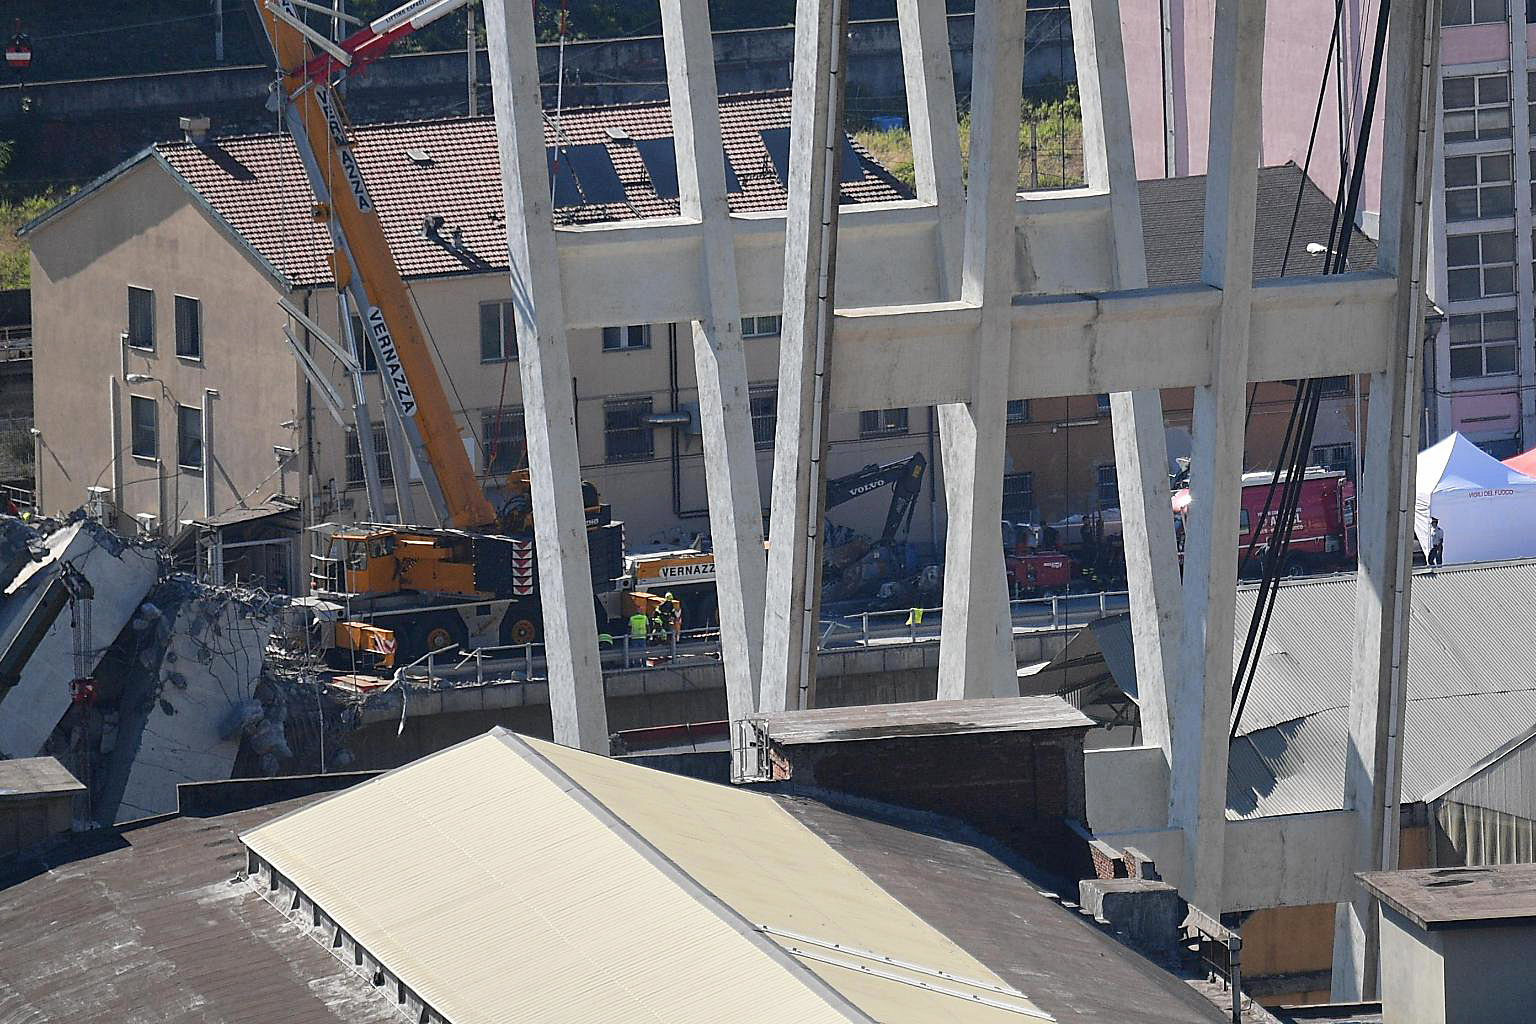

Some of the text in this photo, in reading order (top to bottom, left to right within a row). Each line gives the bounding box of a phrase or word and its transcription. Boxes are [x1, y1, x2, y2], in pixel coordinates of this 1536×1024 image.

[317, 90, 370, 210] VERNAZZA
[370, 309, 415, 414] VERNAZZA
[849, 480, 884, 496] VOLVO
[662, 564, 716, 577] VERNAZZ
